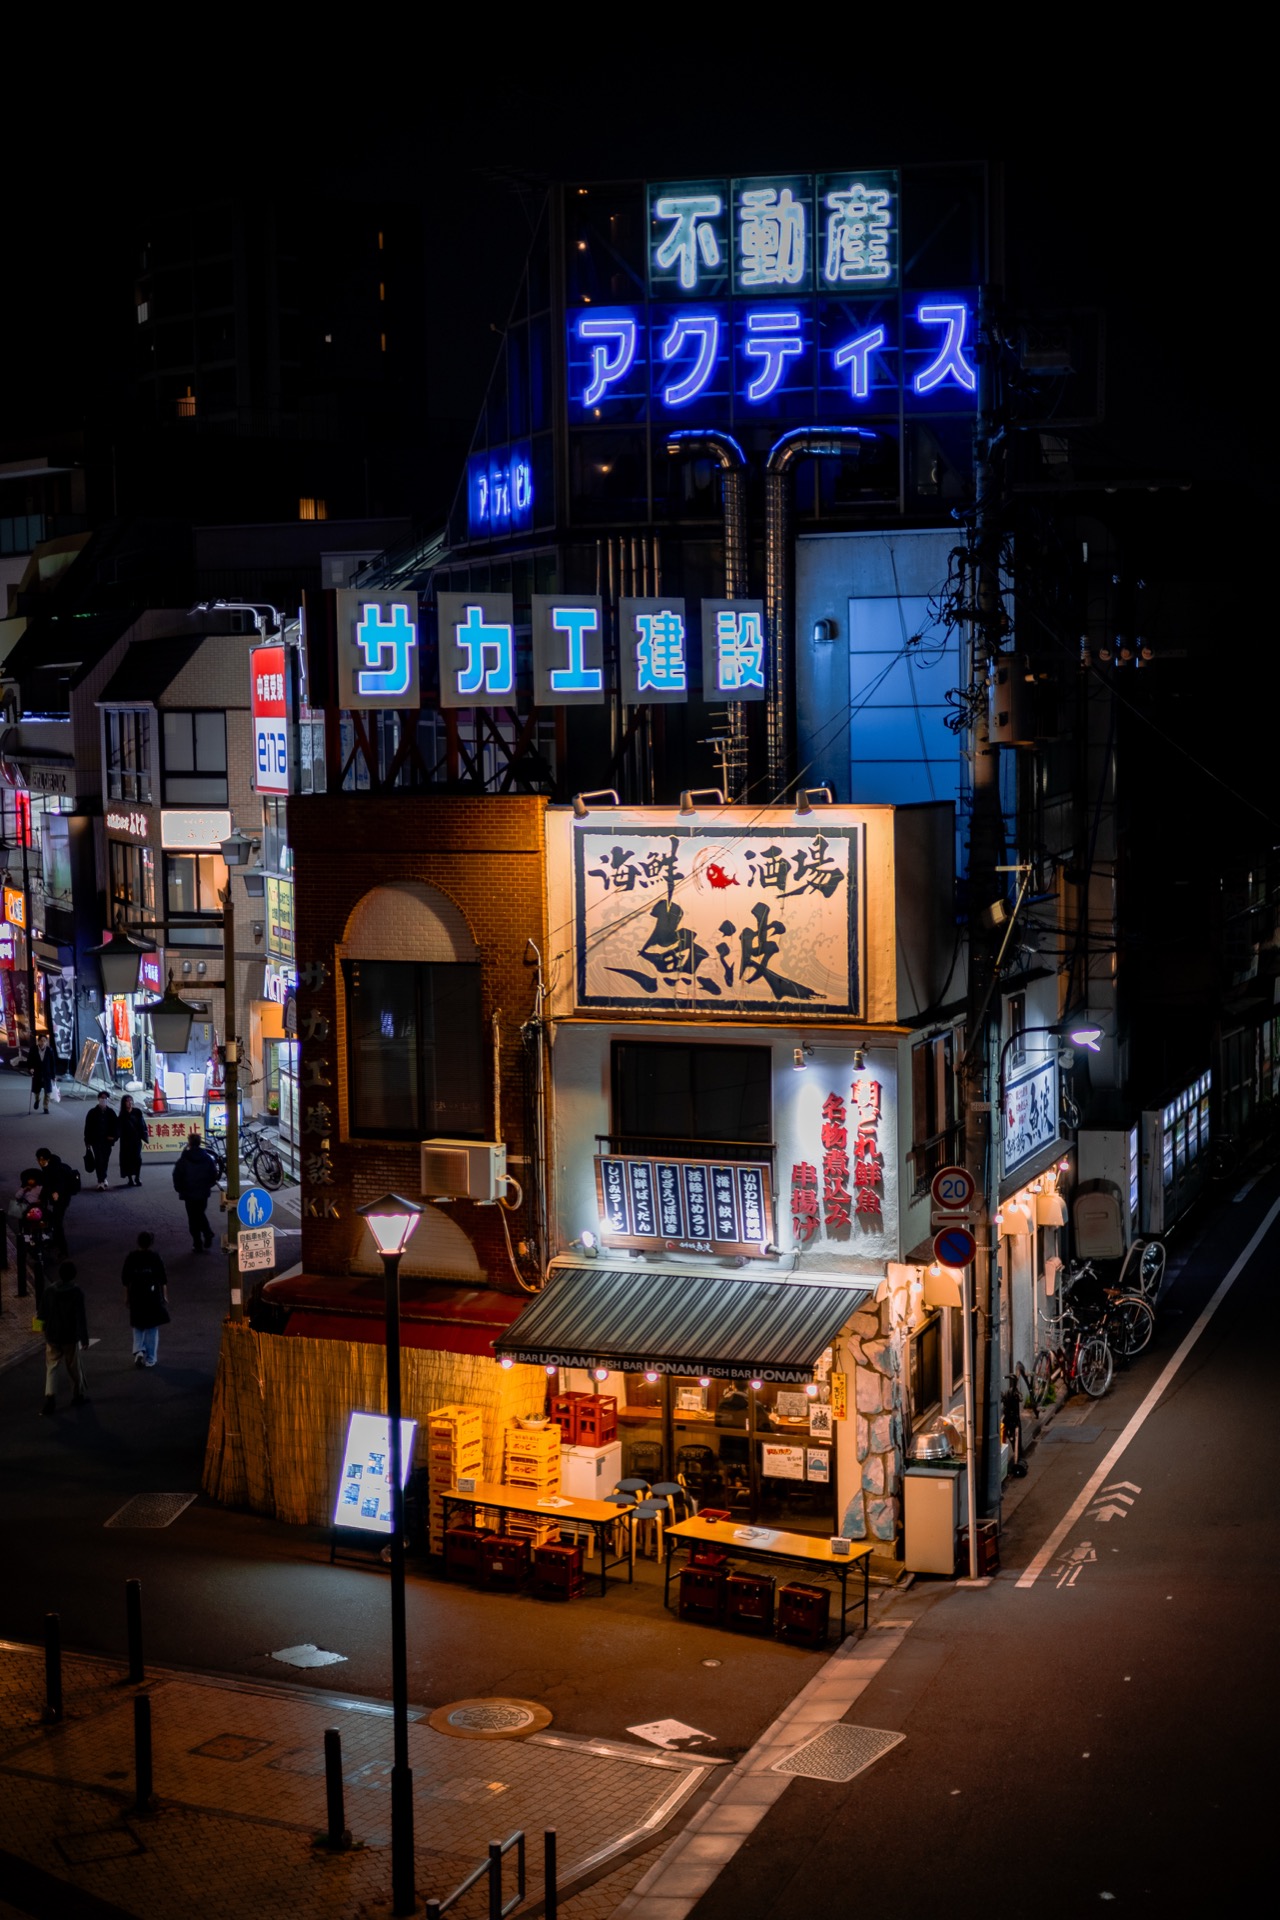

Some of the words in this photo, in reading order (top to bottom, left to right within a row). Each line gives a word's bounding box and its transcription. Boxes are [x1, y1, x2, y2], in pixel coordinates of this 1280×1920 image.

[656, 183, 891, 289] 不動産
[579, 304, 977, 407] アクティス
[356, 603, 765, 695] サカエ建設
[257, 732, 287, 774] ena
[588, 834, 686, 908] 海鮮
[743, 834, 845, 899] 酒場
[604, 898, 828, 1001] 魚波
[820, 1092, 853, 1229] 名物煮込み
[942, 1180, 966, 1199] 20
[240, 1231, 272, 1242] 自転車を除く
[633, 1167, 651, 1232] 海鮮ばくだん
[715, 1175, 733, 1233] 海老餃子
[790, 1160, 821, 1244] 串揚げ
[519, 1352, 539, 1364] BAR
[540, 1353, 597, 1368] UONAMI
[600, 1359, 622, 1371] FISH
[623, 1360, 643, 1372] BAR
[644, 1361, 705, 1377] UONAMI
[707, 1366, 730, 1378] FISH
[731, 1368, 752, 1379] BAR
[752, 1369, 813, 1384] UONAMI
